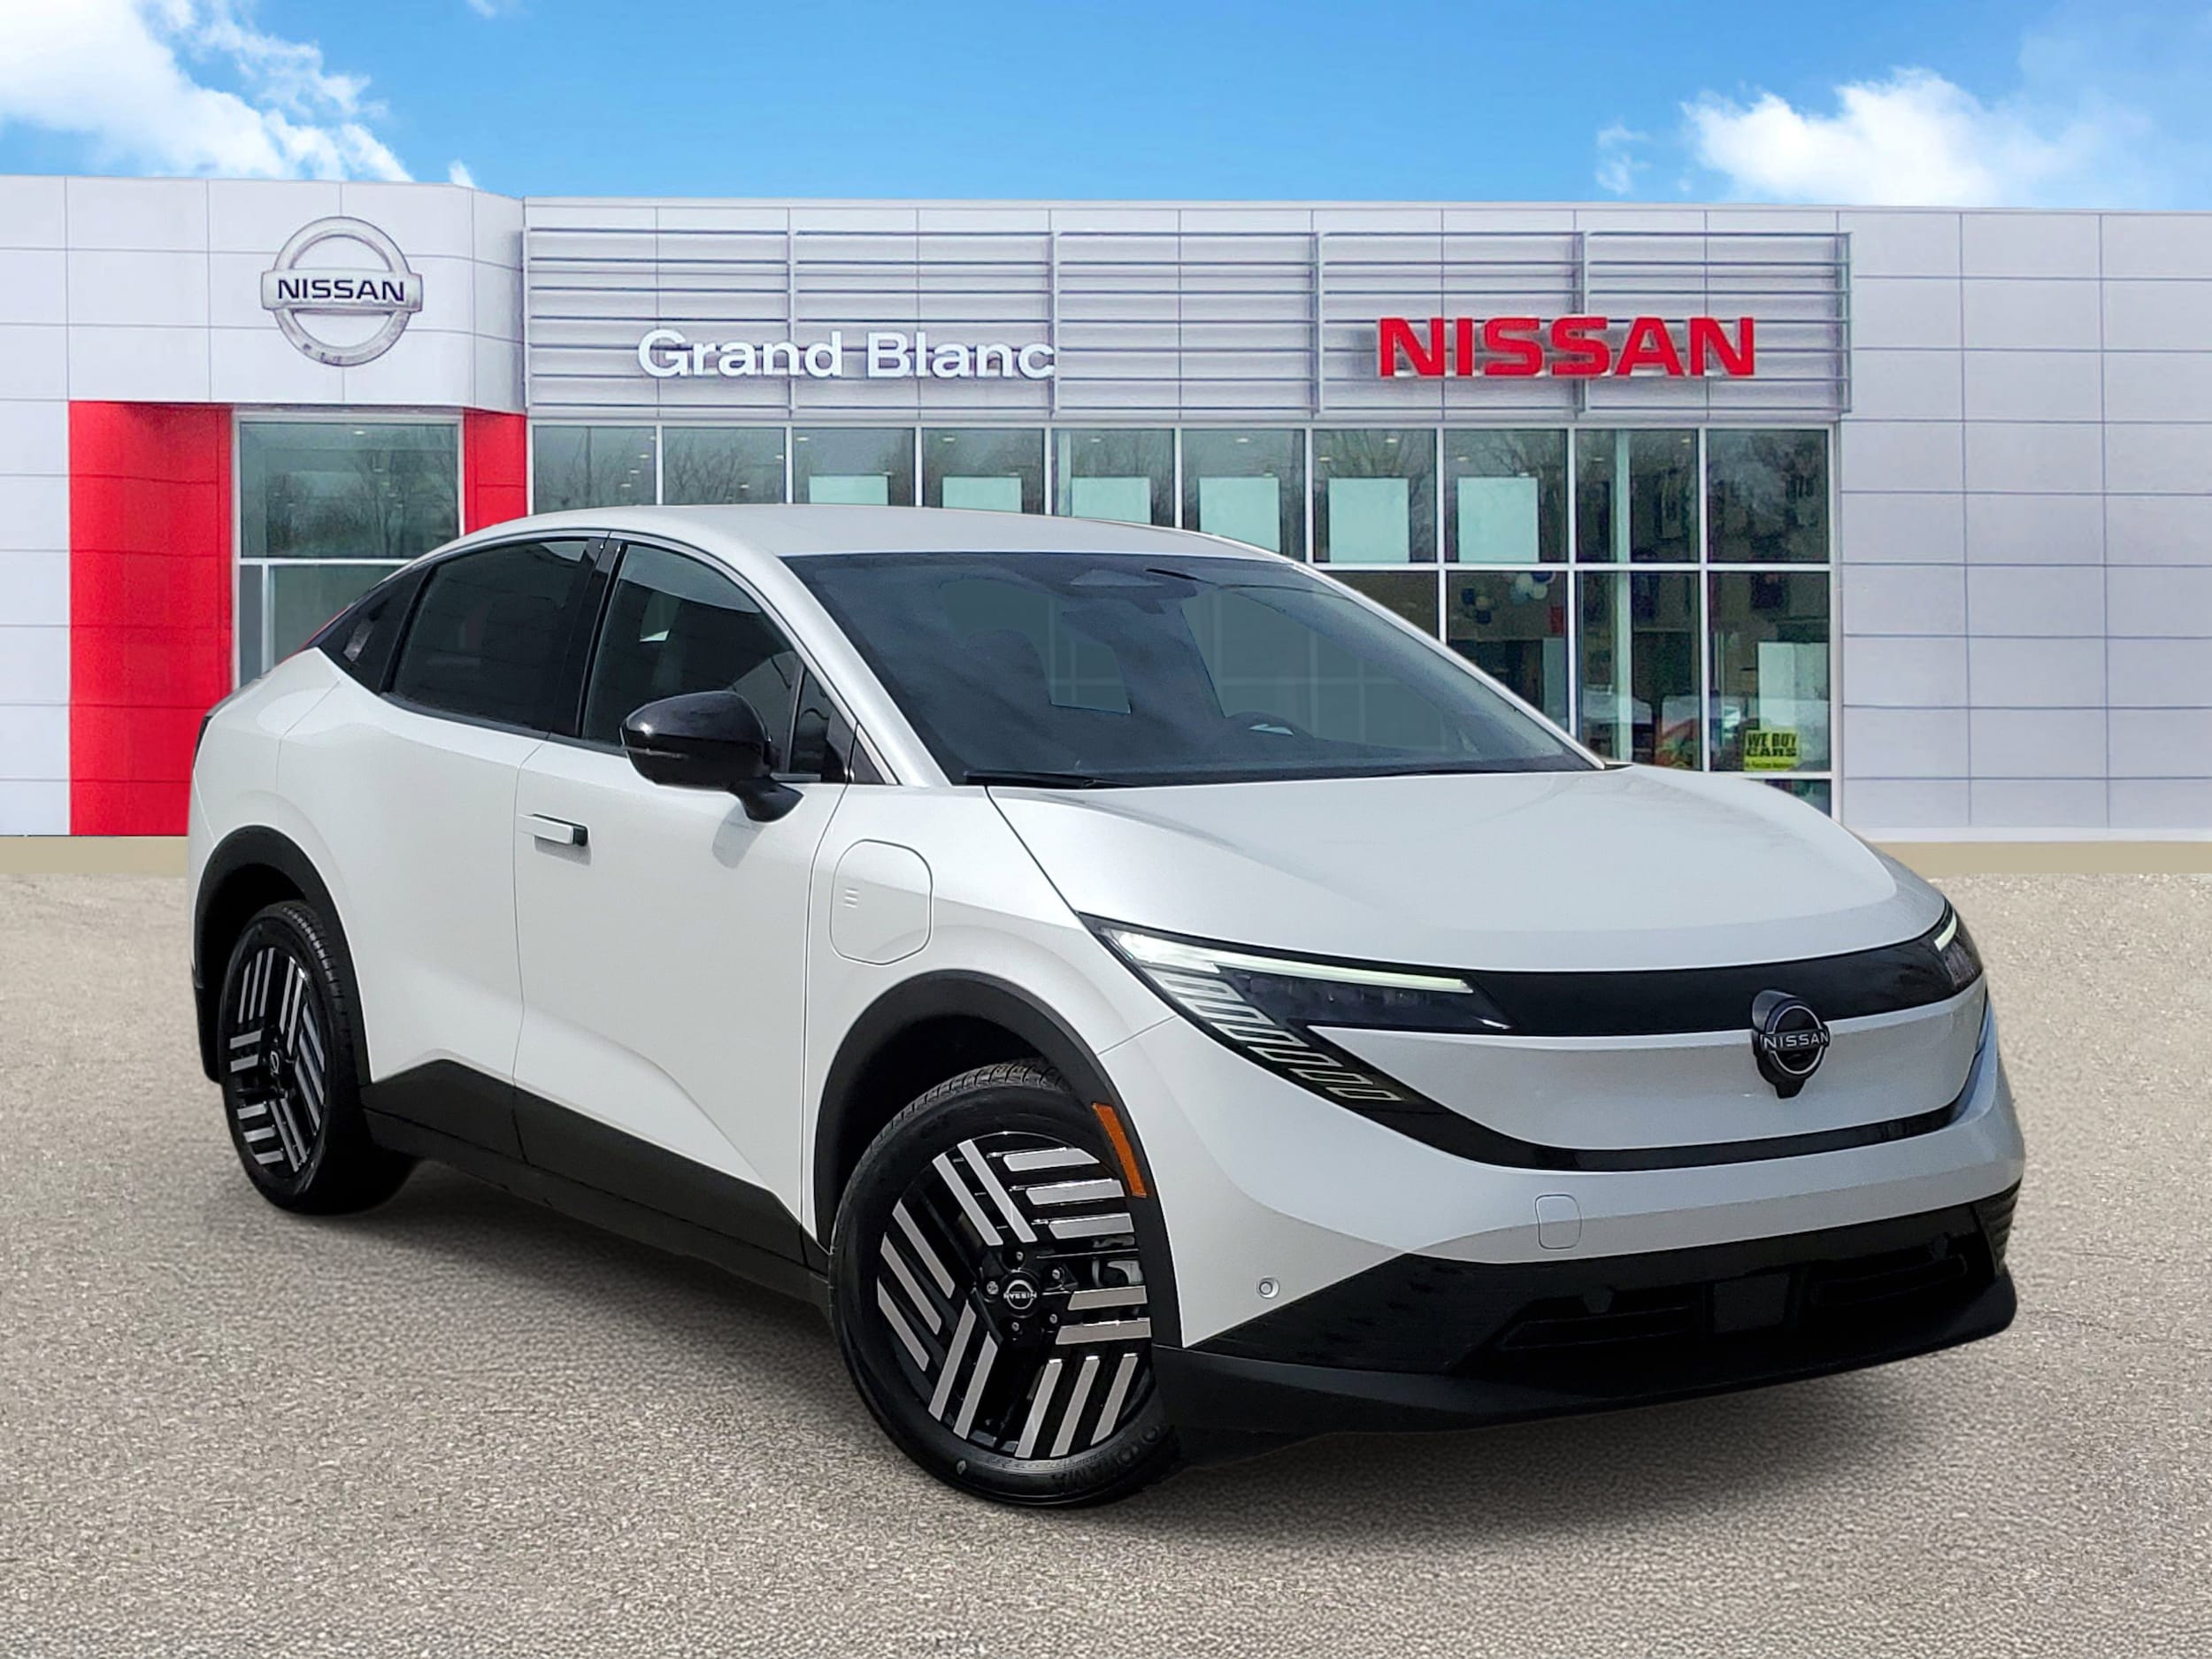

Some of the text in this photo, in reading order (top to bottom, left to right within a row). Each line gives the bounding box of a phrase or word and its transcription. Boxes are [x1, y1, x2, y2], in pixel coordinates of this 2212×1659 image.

[278, 278, 404, 302] NISSAN
[638, 328, 1056, 380] Grand Blanc
[1379, 317, 1755, 377] NISSAN
[1747, 733, 1798, 748] WE BUY
[1747, 748, 1797, 757] CARS
[1763, 1032, 1829, 1048] NISSAN
